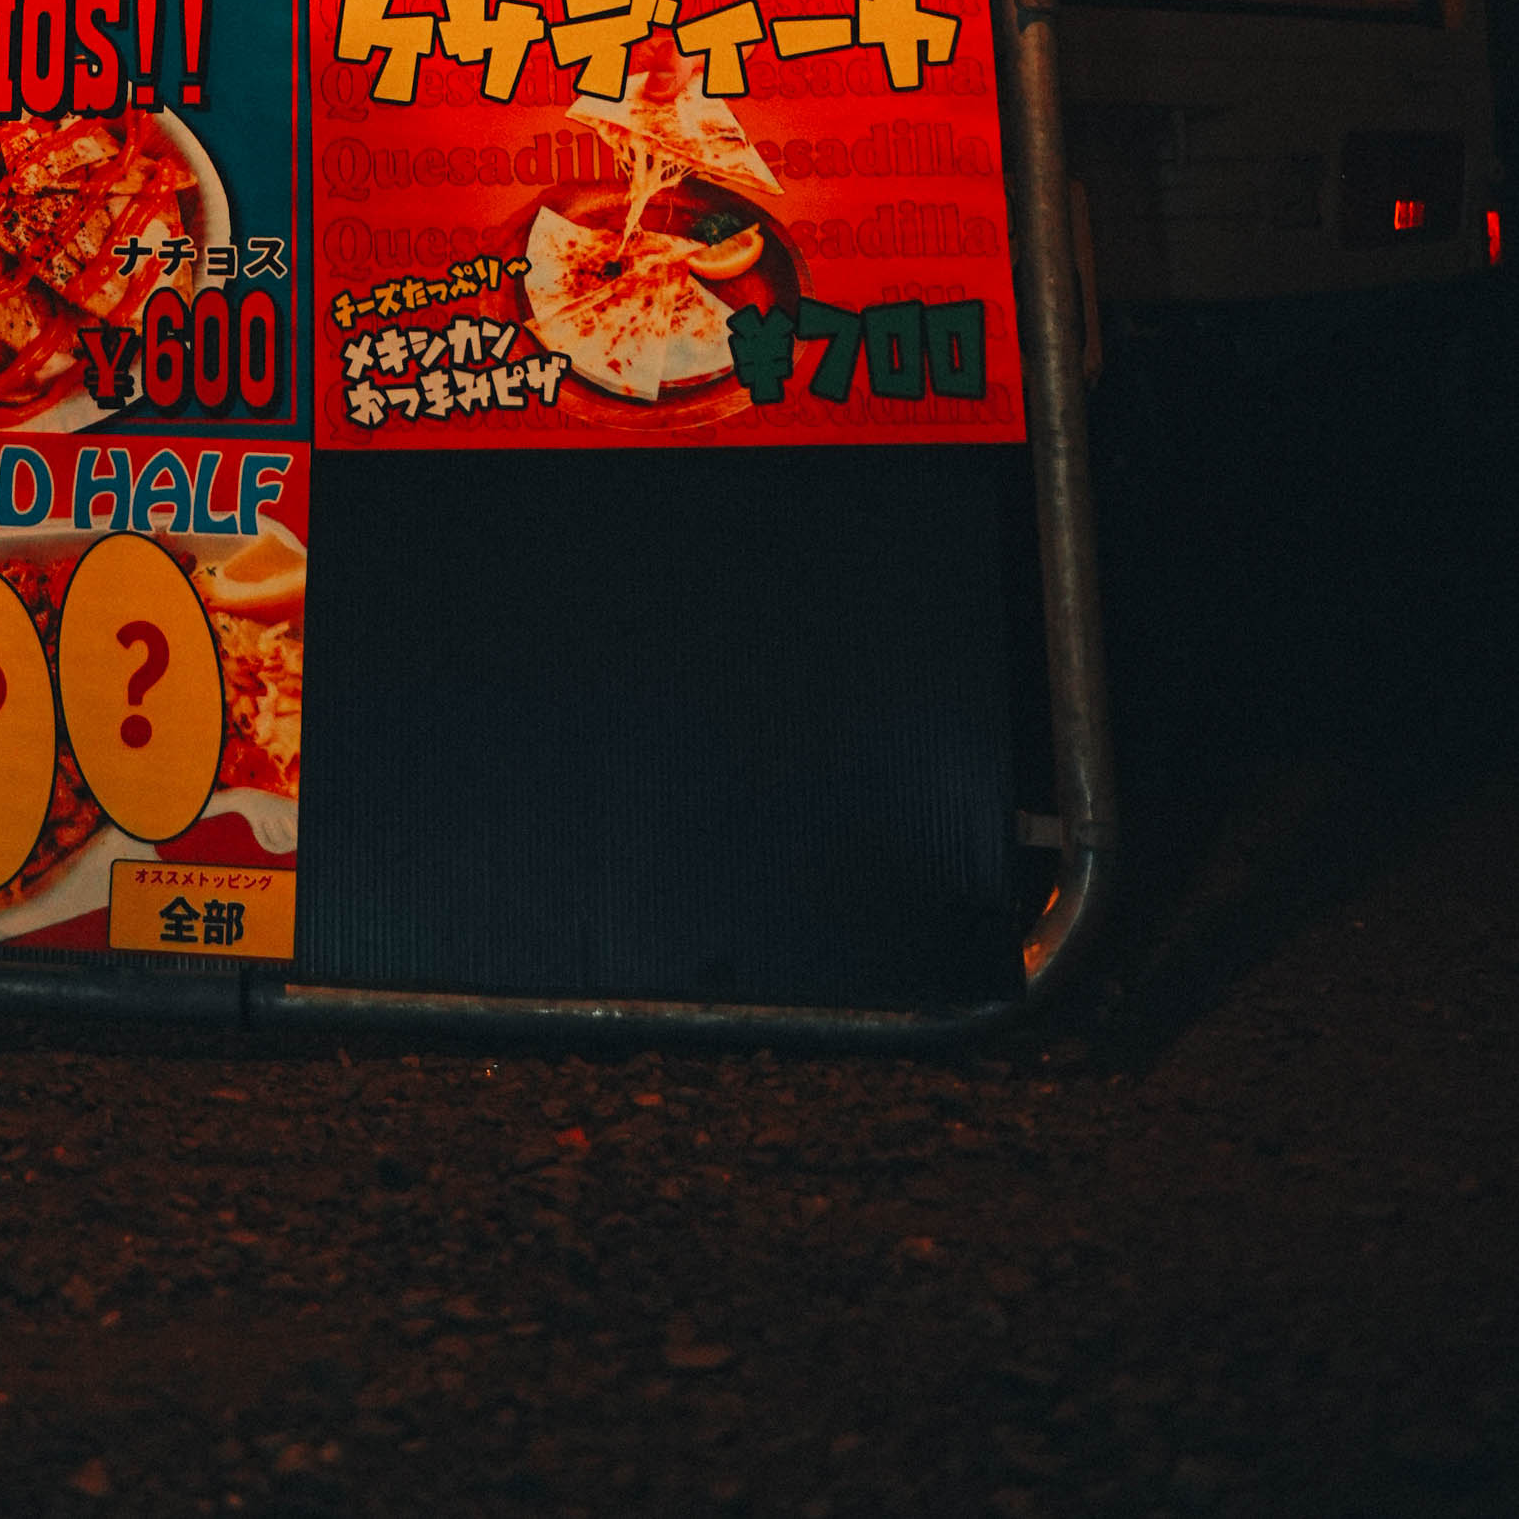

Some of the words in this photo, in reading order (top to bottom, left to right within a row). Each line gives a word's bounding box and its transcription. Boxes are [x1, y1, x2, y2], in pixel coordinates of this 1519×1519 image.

[113, 236, 289, 281] ナチョス
[81, 288, 279, 410] ¥600
[341, 316, 522, 381] メキシカン
[729, 297, 986, 405] ¥700
[345, 352, 572, 427] おつまみピザ
[73, 451, 293, 537] HALF
[115, 620, 170, 749] ?
[135, 869, 273, 891] オススメトッピング
[159, 895, 246, 945] 全部
